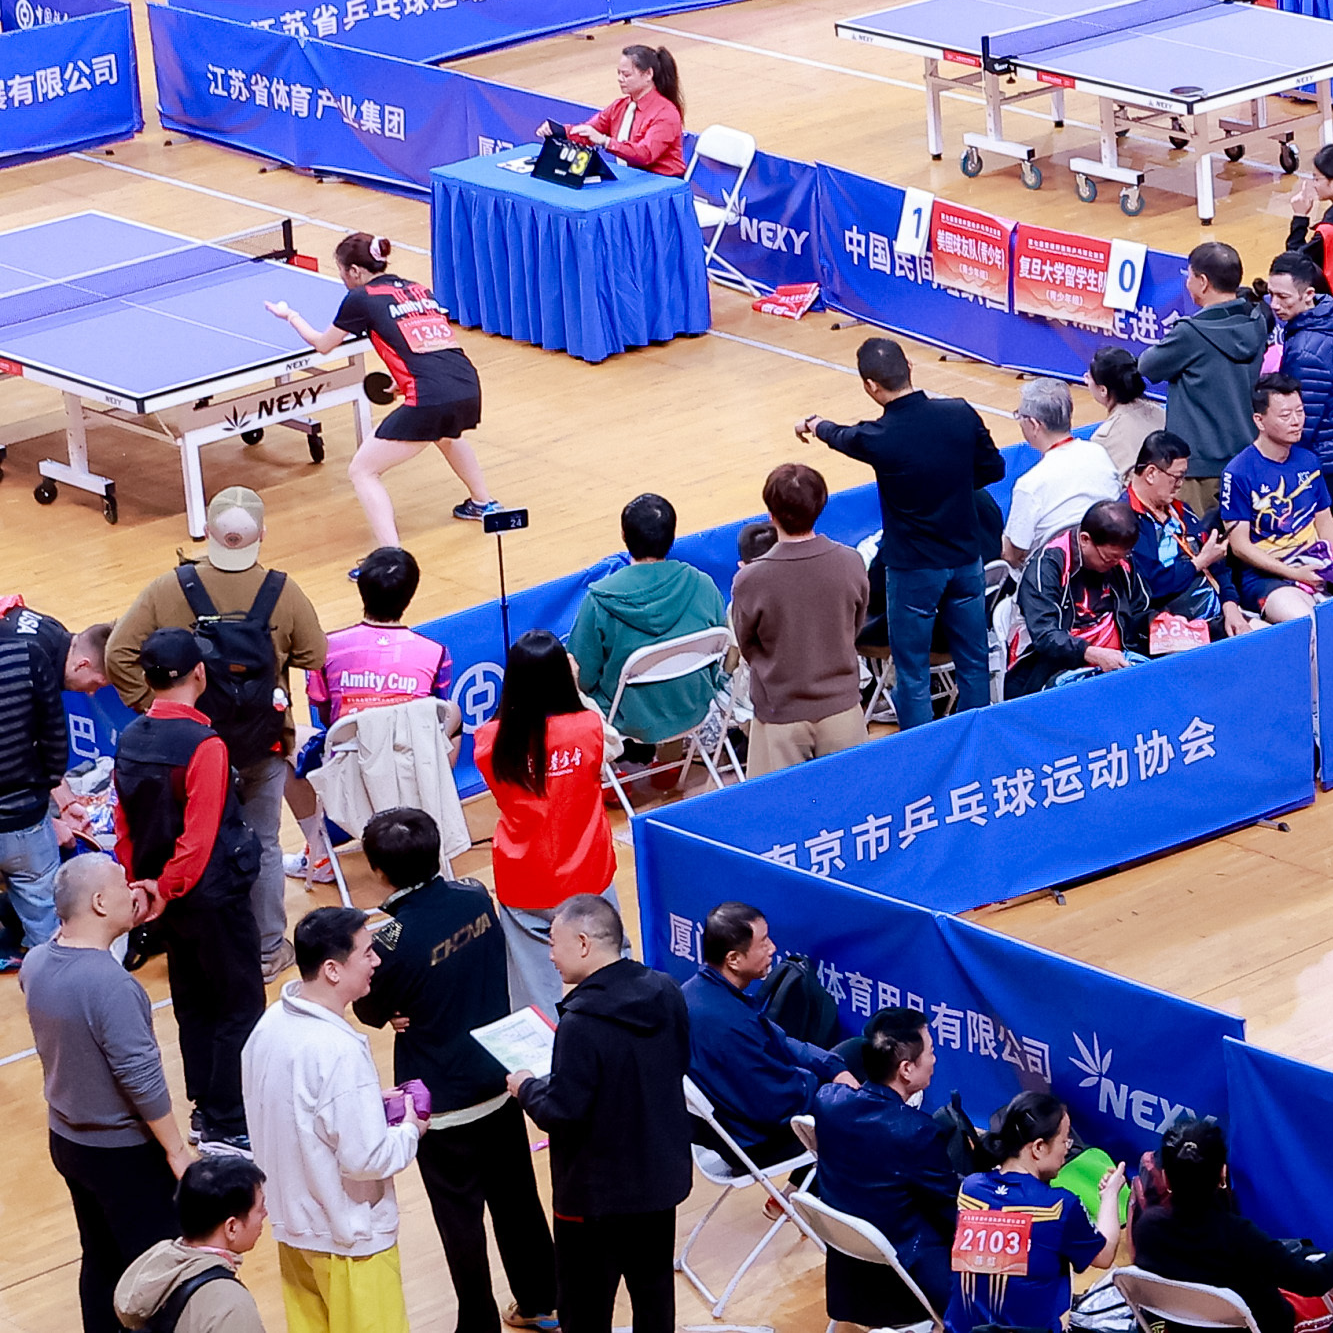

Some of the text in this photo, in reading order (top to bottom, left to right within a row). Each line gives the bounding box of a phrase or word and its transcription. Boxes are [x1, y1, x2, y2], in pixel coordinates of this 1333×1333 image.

[207, 64, 406, 140] 江苏省体育产业集团
[572, 150, 590, 174] 3
[740, 216, 809, 254] NEXY
[913, 208, 922, 238] 1
[1119, 260, 1135, 291] 0
[410, 321, 452, 343] 1343
[257, 384, 326, 421] NEXY
[340, 670, 418, 694] Amity Cup
[960, 1230, 1019, 1255] 2103
